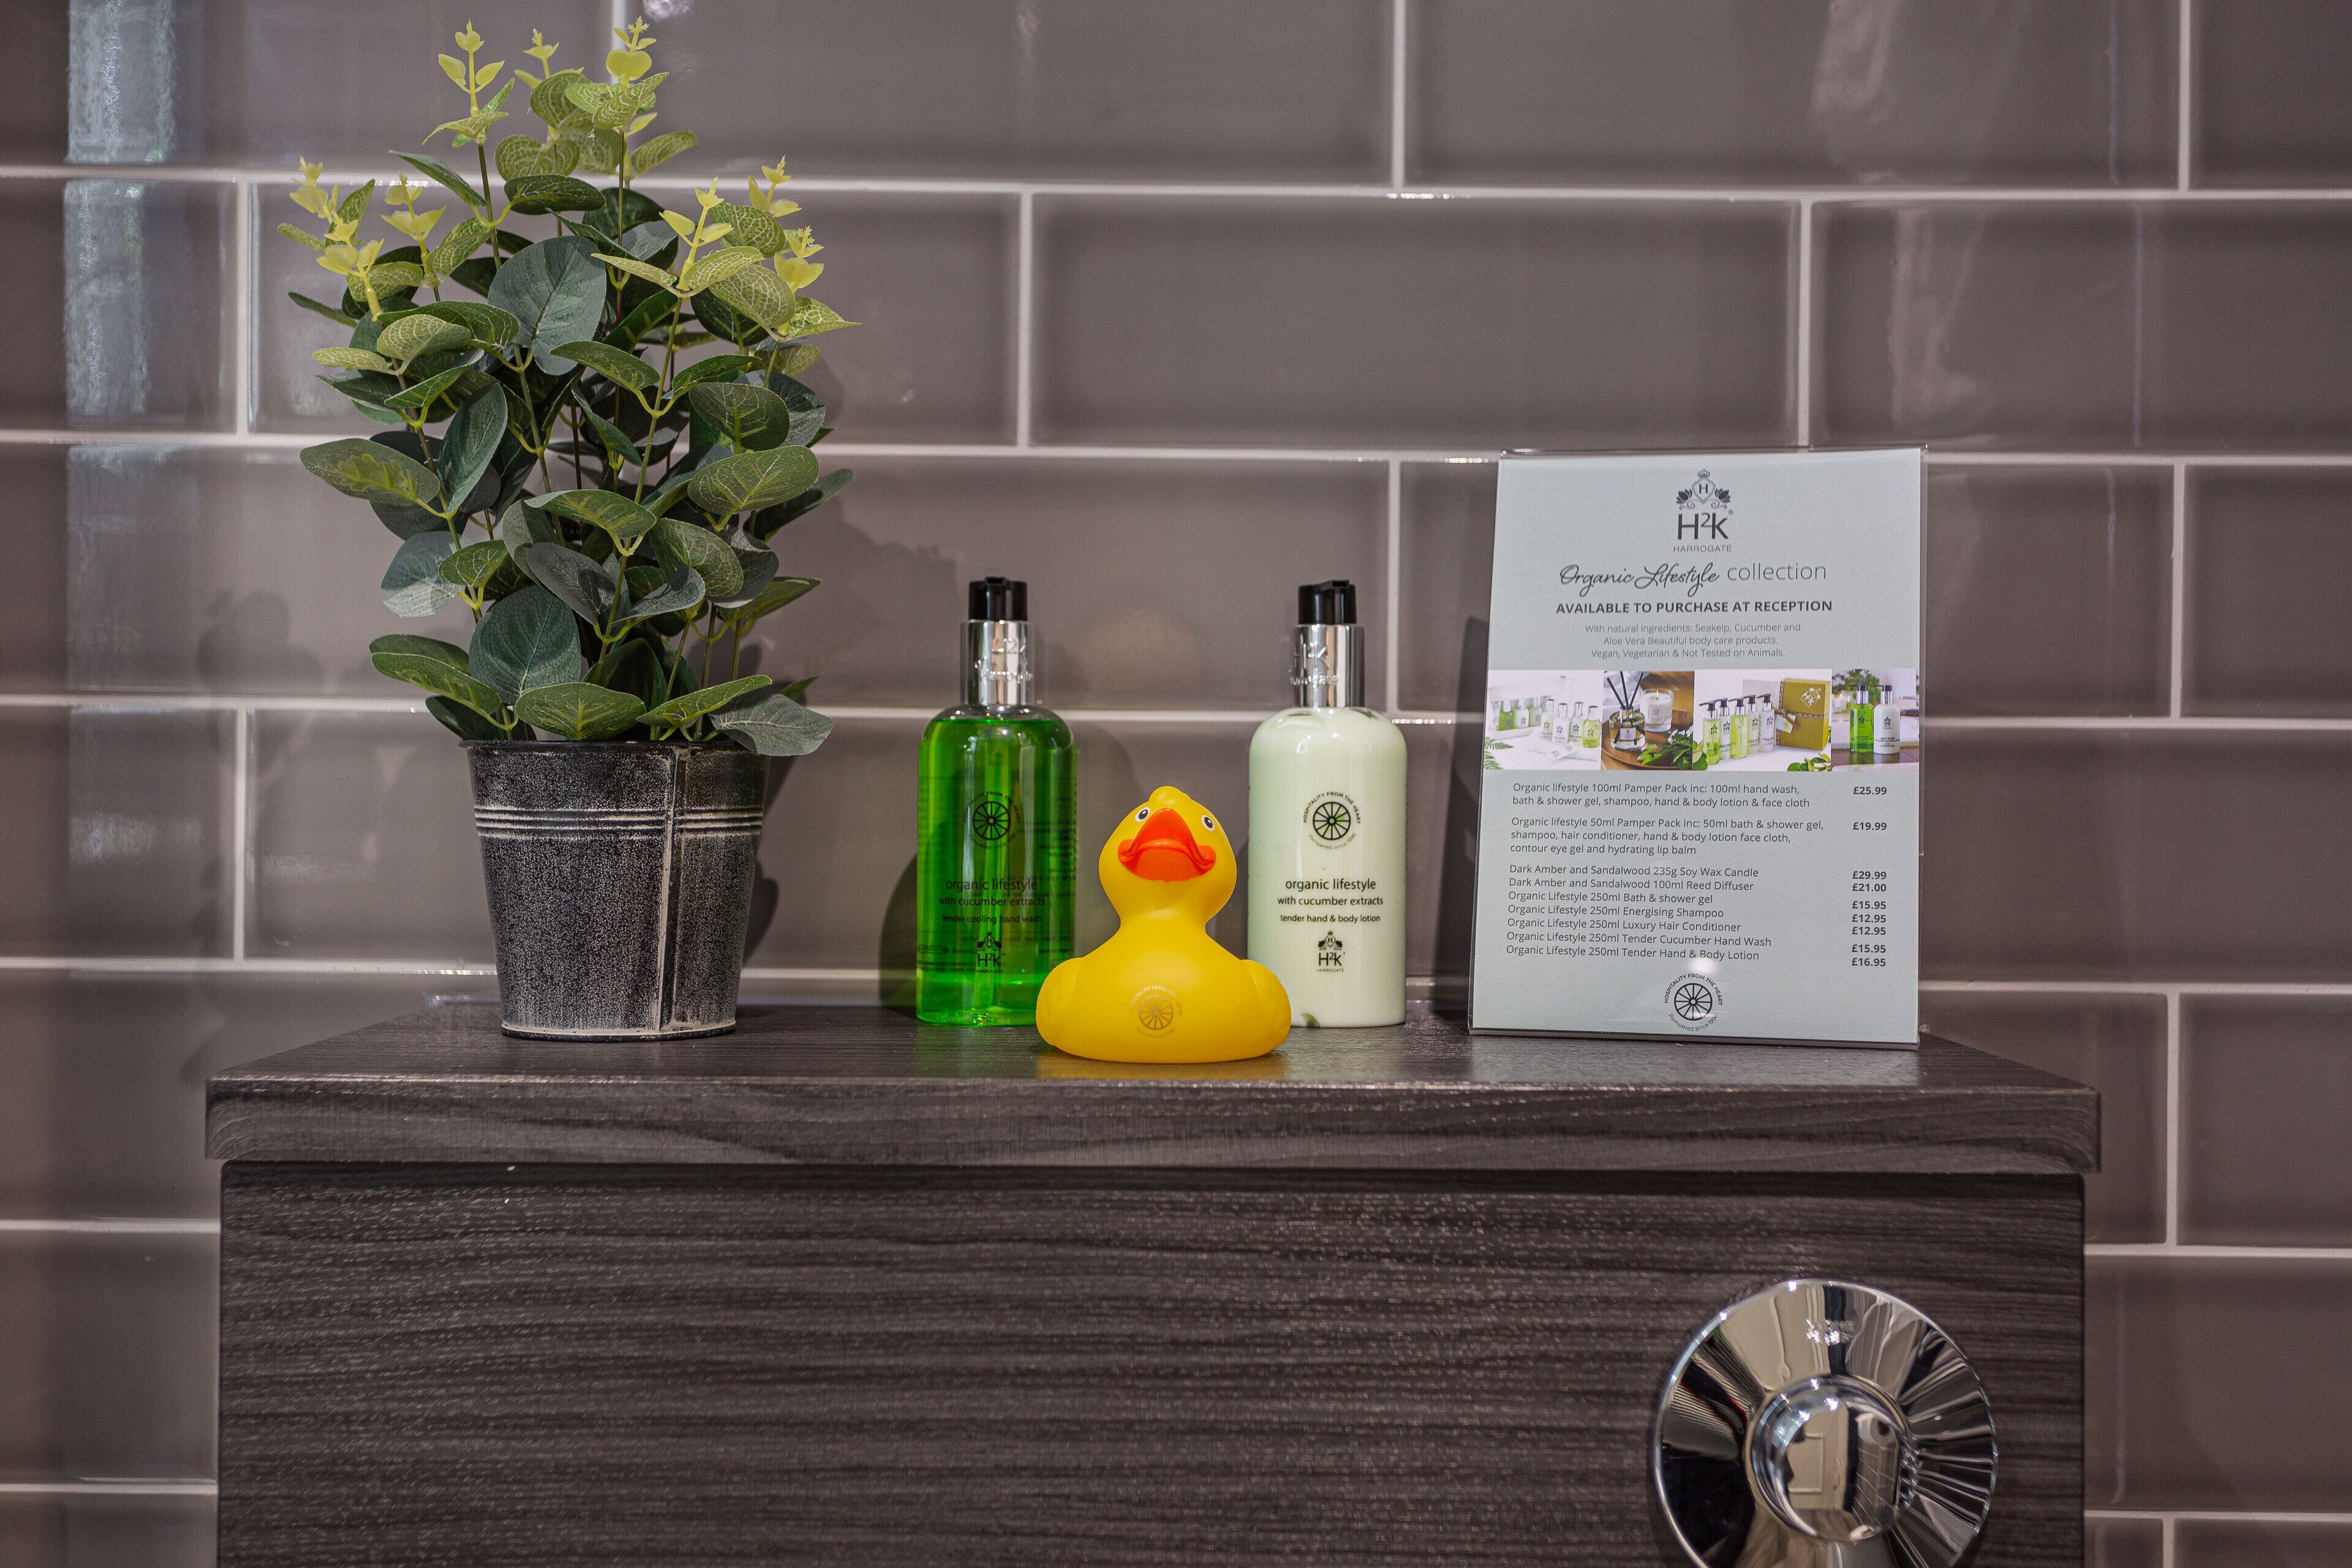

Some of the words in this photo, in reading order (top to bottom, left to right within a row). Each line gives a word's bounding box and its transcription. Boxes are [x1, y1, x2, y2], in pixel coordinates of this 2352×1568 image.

[1559, 564, 1634, 597] Organic
[1634, 562, 1720, 598] Lifestyle
[1727, 562, 1826, 581] collection
[1556, 603, 1629, 614] AVAILABLE
[1633, 602, 1652, 613] TO
[1656, 601, 1728, 613] PURCHASE
[1732, 601, 1751, 612] AT
[1754, 600, 1832, 612] RECEPTION
[1607, 624, 1638, 633] natural
[1734, 623, 1781, 633] Cucumber
[1784, 622, 1801, 631] and
[1513, 783, 1550, 794] Organic
[1553, 782, 1589, 794] lifestyle
[1592, 783, 1621, 793] 100ml
[1624, 784, 1662, 795] Pamper
[1665, 783, 1687, 793] Pack
[1690, 784, 1707, 793] inc:
[1710, 784, 1740, 794] 100ml
[1743, 784, 1768, 794] hand
[1771, 785, 1800, 795] wash,
[1853, 786, 1887, 795] £25.99
[1512, 796, 1534, 805] bath
[1537, 796, 1544, 805] &
[1547, 796, 1582, 805] shower
[1584, 796, 1601, 808] gel,
[1604, 796, 1652, 808] shampoo,
[1654, 797, 1679, 806] hand
[1683, 797, 1691, 807] &
[1693, 797, 1718, 809] body
[1720, 797, 1748, 807] lotion
[1751, 798, 1759, 807] &
[1762, 797, 1782, 807] face
[1785, 797, 1809, 807] cloth
[1512, 817, 1548, 828] Organic
[1551, 817, 1588, 829] lifestyle
[1590, 818, 1615, 827] 50ml
[1617, 818, 1656, 829] Pamper
[1658, 818, 1681, 827] Pack
[1703, 819, 1728, 828] 50ml
[1731, 819, 1753, 829] bath
[1756, 820, 1764, 829] &
[1766, 820, 1804, 829] shower
[1806, 820, 1823, 832] gel,
[1852, 821, 1887, 831] £19.99
[1511, 830, 1558, 842] shampoo,
[1561, 831, 1580, 840] hair
[1582, 831, 1640, 842] conditioner,
[1643, 831, 1668, 841] hand
[1671, 832, 1679, 841] &
[1681, 832, 1706, 843] body
[1709, 832, 1737, 842] lotion
[1740, 832, 1761, 842] face
[1763, 833, 1790, 844] cloth,
[1510, 844, 1548, 853] contour
[1550, 845, 1567, 855] eye
[1569, 844, 1584, 856] gel
[1586, 844, 1605, 853] and
[1608, 844, 1654, 856] hydrating
[1657, 845, 1669, 857] lip
[1672, 845, 1696, 854] balm
[1510, 864, 1532, 873] Dark
[1534, 864, 1567, 874] Amber
[1569, 865, 1588, 874] and
[1591, 865, 1651, 875] Sandalwood
[1653, 867, 1678, 878] 235g
[1679, 867, 1698, 878] Soy
[1700, 867, 1721, 876] Wax
[1724, 868, 1758, 877] Candle
[1852, 870, 1887, 880] £29.99
[946, 879, 989, 892] organic
[992, 878, 1038, 892] lifestyle
[1285, 879, 1329, 892] organic
[1333, 878, 1377, 892] lifestyle
[1509, 878, 1532, 887] Dark
[1534, 878, 1567, 888] Amber
[1569, 878, 1588, 888] and
[1590, 878, 1650, 889] Sandalwood
[1653, 880, 1683, 889] 100ml
[1686, 881, 1711, 890] Reed
[1714, 881, 1754, 891] Diffuser
[1852, 883, 1887, 892] £21.00
[938, 896, 957, 906] with
[958, 896, 1006, 907] cucumber
[1009, 897, 1046, 907] extracts
[1277, 895, 1296, 905] with
[1298, 896, 1348, 905] cucumber
[1349, 897, 1384, 905] extracts
[1508, 891, 1546, 902] Organic
[1548, 891, 1588, 903] Lifestyle
[1590, 892, 1621, 902] 250ml
[1624, 893, 1646, 902] Bath
[1649, 893, 1657, 903] &
[1659, 893, 1696, 903] shower
[1698, 894, 1713, 906] gel
[1852, 900, 1887, 910] £15.95
[1508, 904, 1545, 916] Organic
[1548, 905, 1588, 917] Lifestyle
[1589, 906, 1620, 915] 250ml
[1623, 907, 1674, 919] Energising
[1676, 907, 1724, 920] Shampoo
[1852, 914, 1887, 923] £12.95
[967, 914, 997, 925] cooling
[1338, 914, 1359, 924] body
[1507, 918, 1545, 929] Organic
[1547, 918, 1587, 930] Lifestyle
[1589, 919, 1619, 929] 250ml
[1623, 920, 1657, 932] Luxury
[1659, 921, 1680, 930] Hair
[1682, 921, 1741, 932] Conditioner
[1852, 926, 1887, 936] £12.95
[1507, 932, 1544, 943] Organic
[1547, 932, 1586, 944] Lifestyle
[1589, 933, 1619, 943] 250ml
[1621, 934, 1657, 944] Tender
[1660, 935, 1712, 945] Cucumber
[1714, 937, 1741, 946] Hand
[1744, 937, 1771, 946] Wash
[1506, 945, 1544, 957] Organic
[1547, 946, 1586, 958] Lifestyle
[1588, 947, 1619, 957] 250ml
[1621, 948, 1657, 957] Tender
[1659, 949, 1686, 959] Hand
[1689, 949, 1697, 959] &
[1700, 949, 1725, 962] Body
[1728, 950, 1759, 960] Lotion
[1851, 944, 1886, 954] £15.95
[1851, 957, 1886, 967] £16.95
[1664, 974, 1687, 1003] HOSPITALITY
[1706, 977, 1716, 987] THE
[1714, 986, 1723, 1006] HEART
[1668, 1013, 1694, 1031] Pampered
